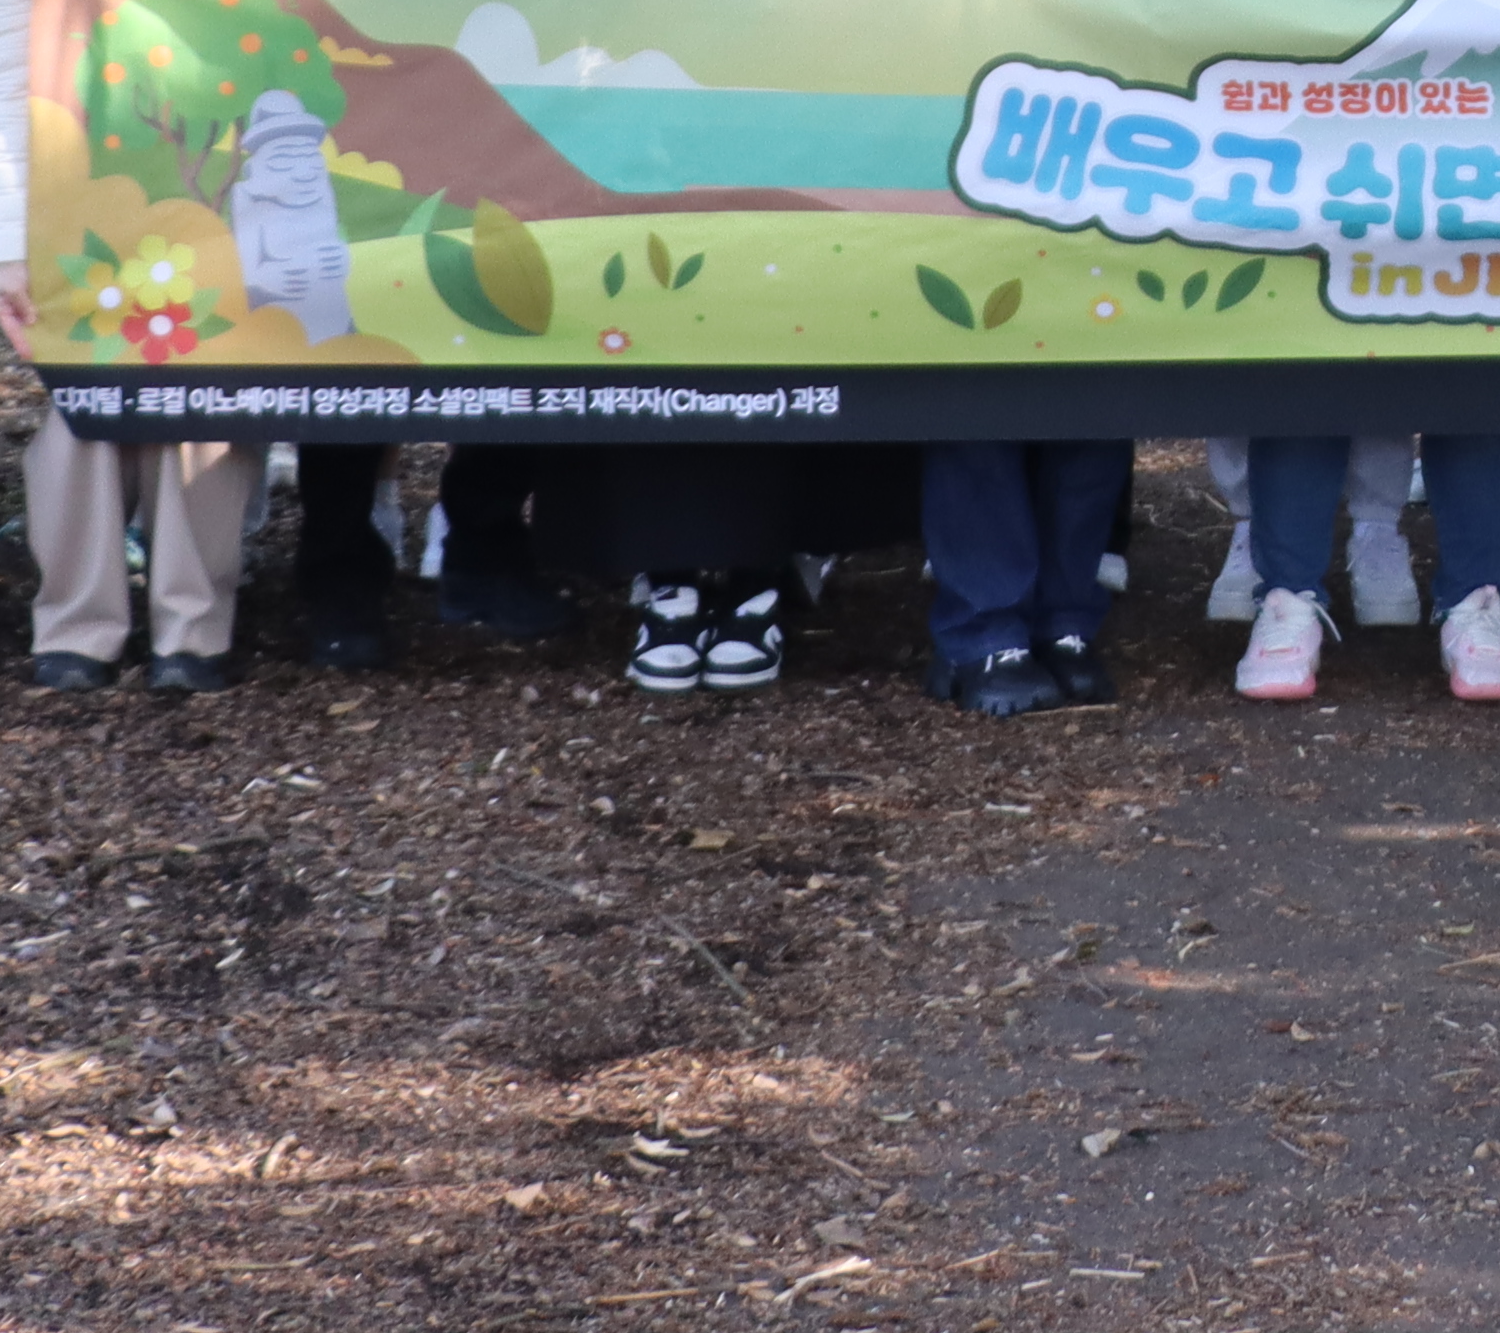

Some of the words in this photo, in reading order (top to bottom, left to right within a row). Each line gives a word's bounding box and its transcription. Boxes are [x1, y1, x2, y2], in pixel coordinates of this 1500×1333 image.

[1221, 80, 1292, 112] 쉼과
[1303, 81, 1408, 114] 성장이
[1419, 81, 1490, 114] 있는
[982, 87, 1302, 231] 배우고
[1351, 252, 1423, 296] in
[53, 386, 123, 415] 디지털
[135, 386, 187, 415] 로컬
[189, 385, 310, 415] 이노베이터
[312, 386, 411, 416] 양성과정
[412, 386, 533, 416] 소셜임팩트
[536, 386, 587, 415] 조직
[589, 386, 786, 417] 재직자(Changer)
[790, 385, 840, 415] 과정
